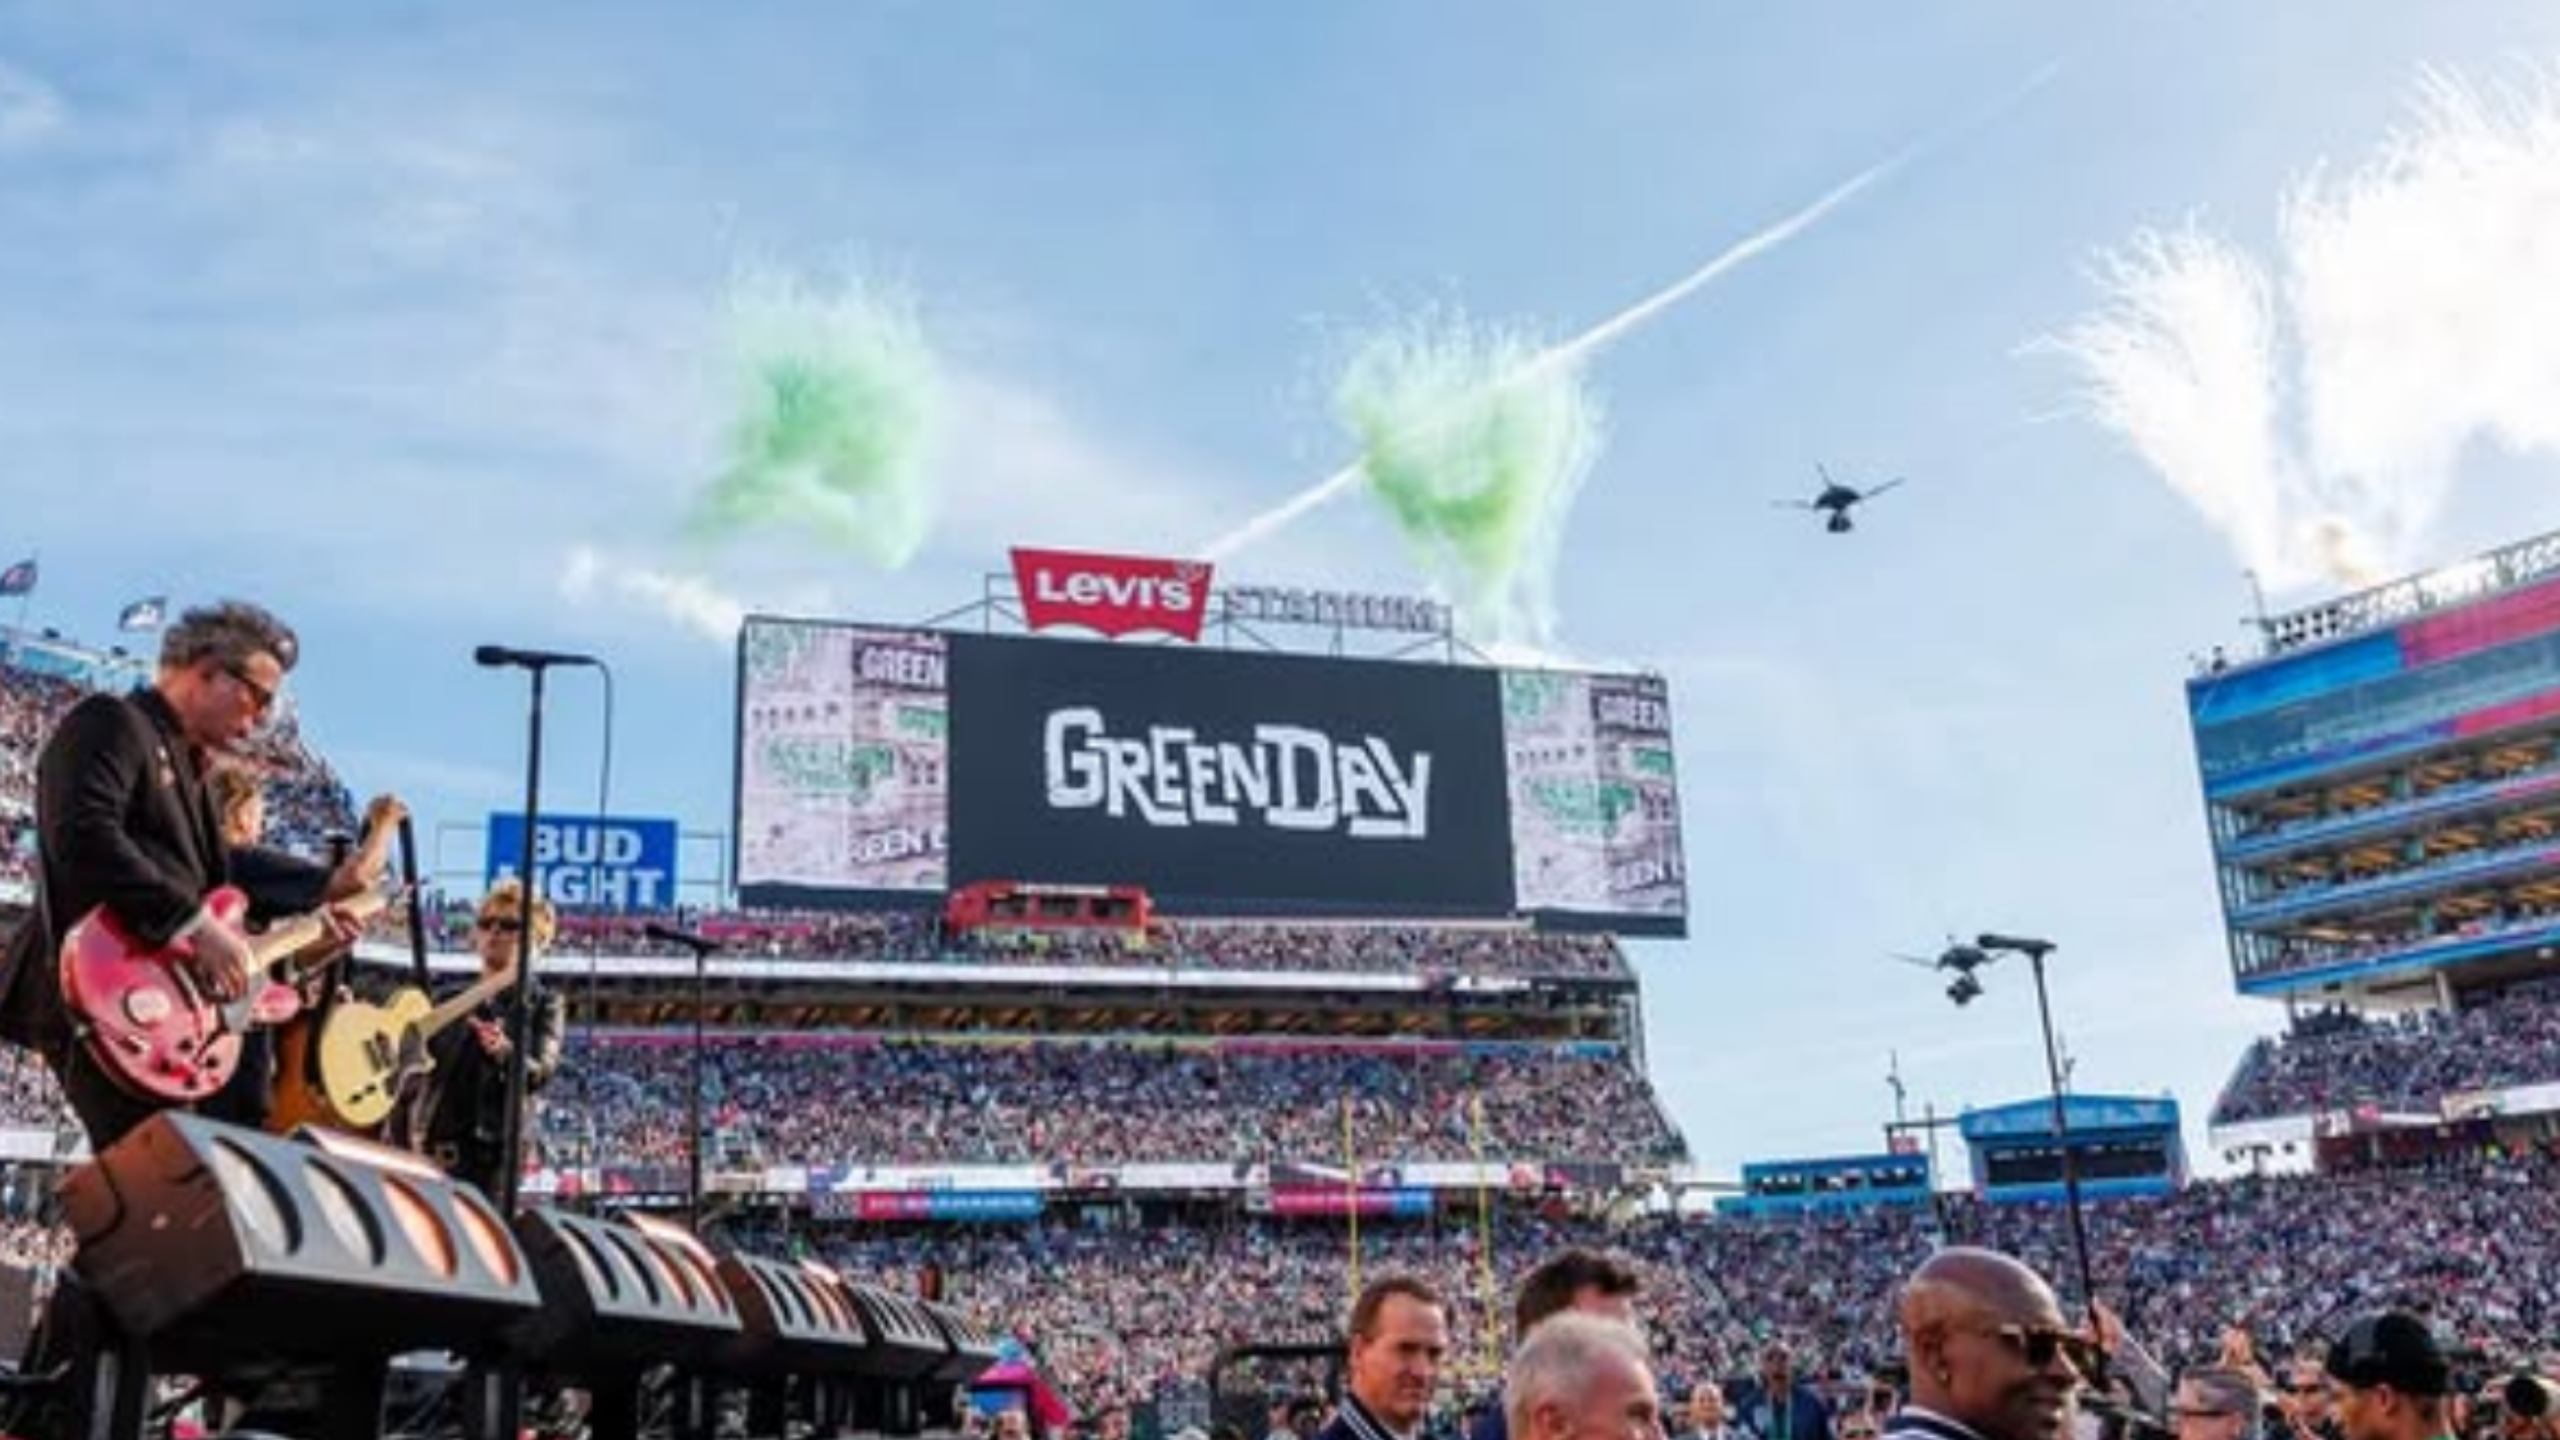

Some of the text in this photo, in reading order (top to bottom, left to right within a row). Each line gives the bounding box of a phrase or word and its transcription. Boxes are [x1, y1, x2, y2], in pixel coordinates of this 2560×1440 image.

[1221, 587, 1444, 633] STADIUM
[534, 824, 644, 865] BUD
[498, 862, 665, 911] IGHT
